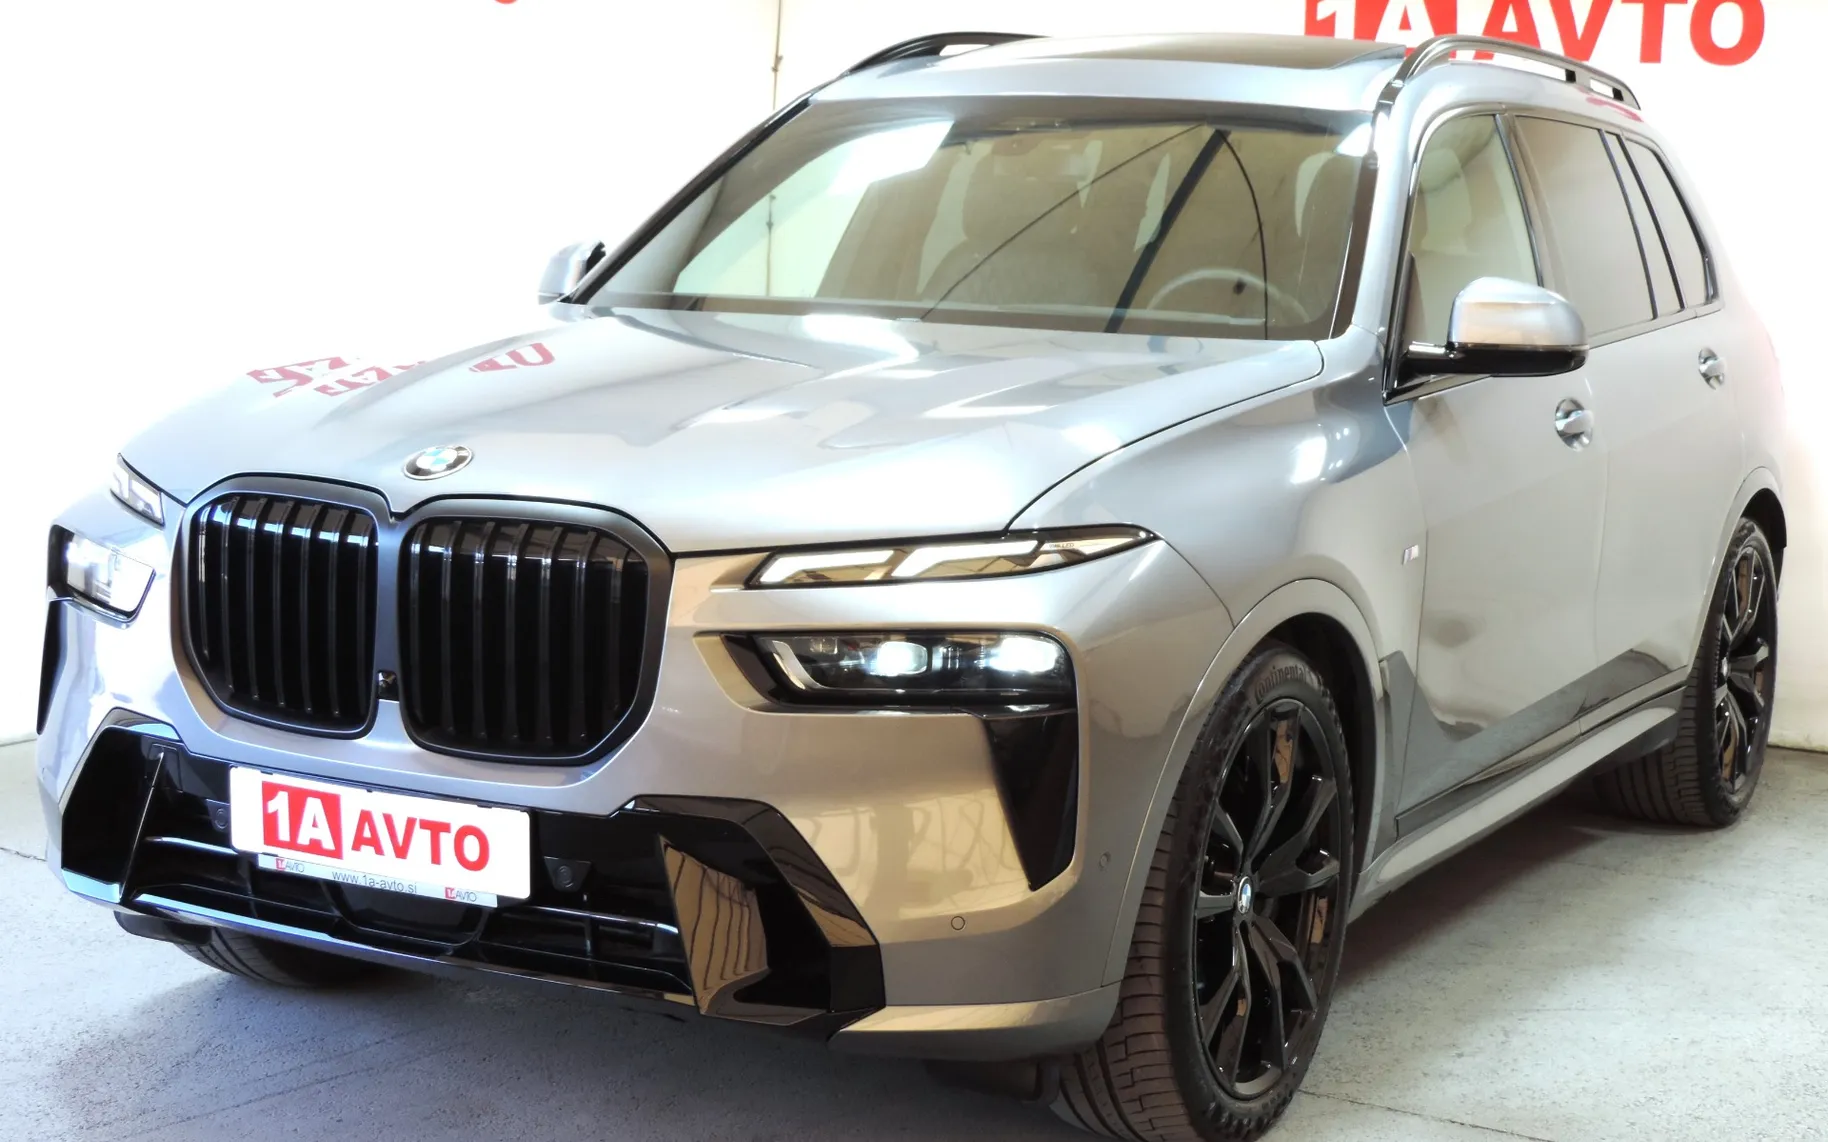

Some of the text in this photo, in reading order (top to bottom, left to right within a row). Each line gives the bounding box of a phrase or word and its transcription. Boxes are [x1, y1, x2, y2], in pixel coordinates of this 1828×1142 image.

[1472, 0, 1765, 66] AVTO
[1255, 664, 1307, 705] Continental
[265, 789, 490, 872] 1A AVTO
[332, 871, 417, 894] www.1a-avto.si
